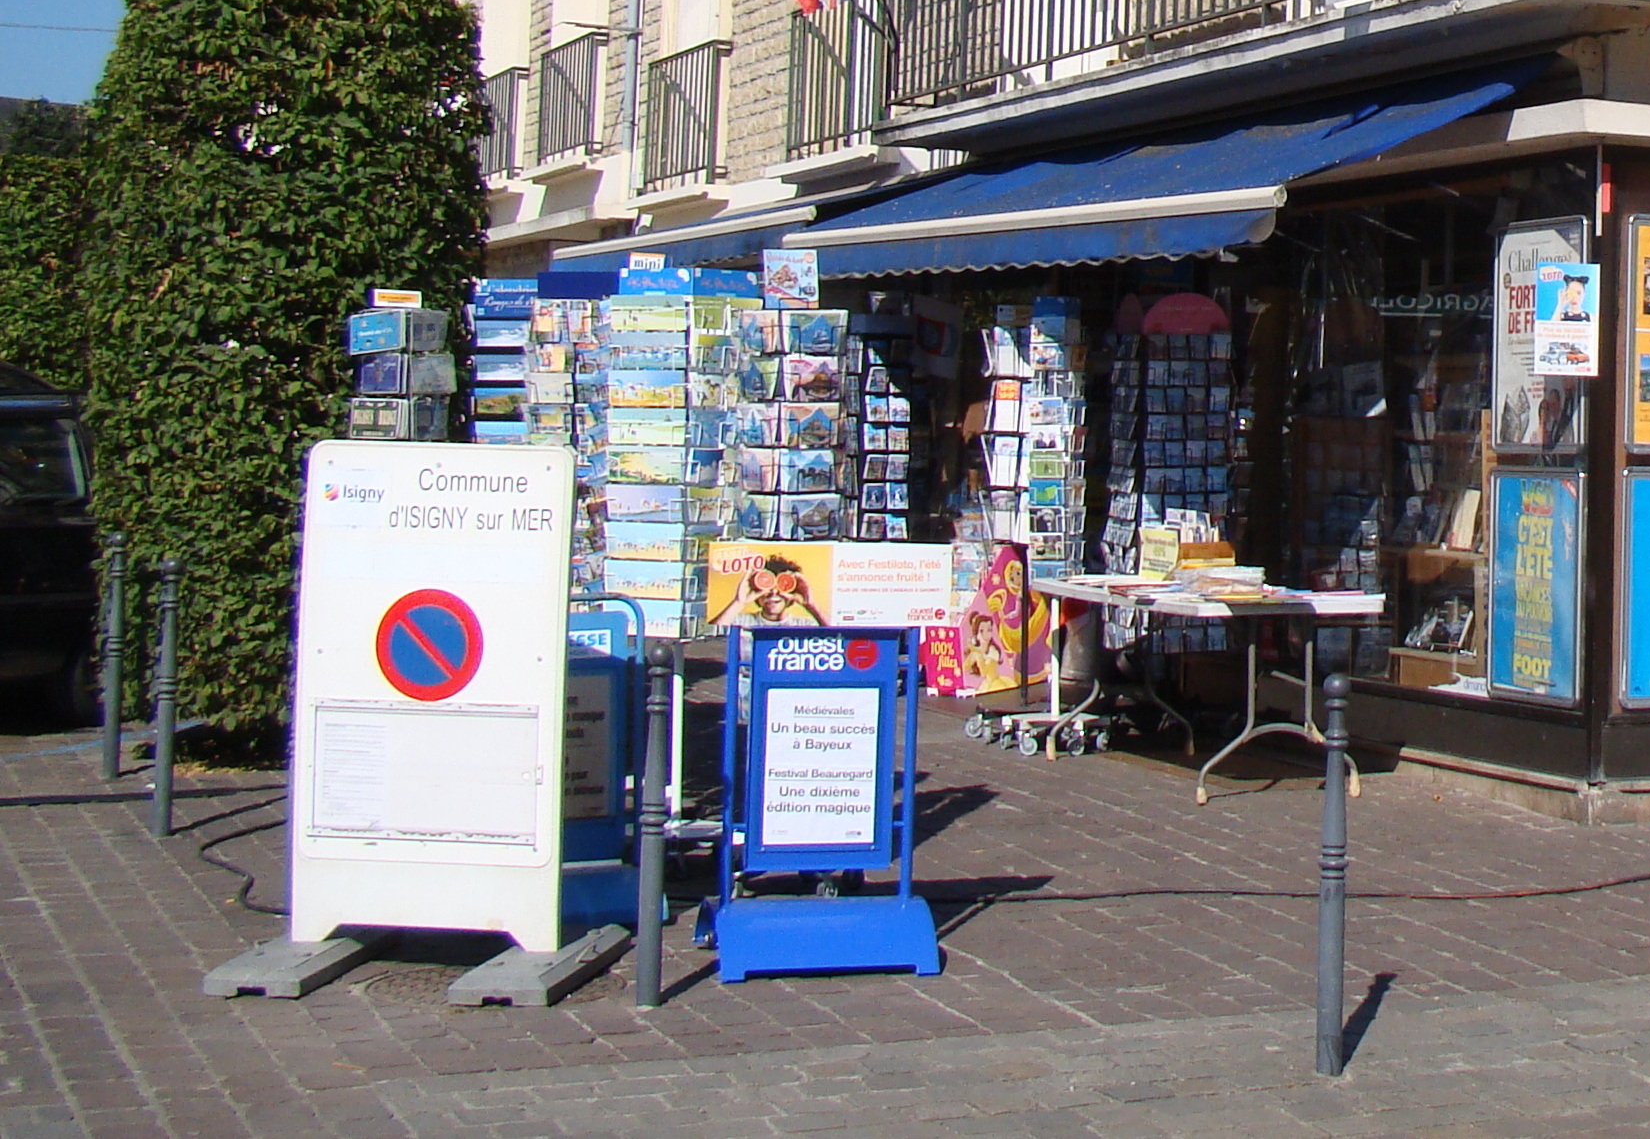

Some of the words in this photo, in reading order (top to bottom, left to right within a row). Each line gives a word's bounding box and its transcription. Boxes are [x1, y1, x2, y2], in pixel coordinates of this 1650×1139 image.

[1508, 311, 1521, 334] DE
[419, 468, 529, 493] Commune
[343, 485, 385, 503] Isigny
[389, 505, 469, 531] d'ISIGNY
[476, 512, 503, 531] sur
[511, 508, 554, 532] MER
[722, 555, 764, 573] LOTO
[838, 560, 865, 569] Avec
[837, 573, 894, 582] s'annonce
[897, 573, 924, 582] fruité
[778, 633, 844, 653] ouest
[930, 641, 955, 655] 100%
[767, 648, 844, 671] france
[1513, 653, 1552, 679] FOOT
[794, 706, 855, 715] Médiévales
[771, 722, 789, 733] Un
[794, 723, 825, 734] beau
[830, 724, 875, 735] succès
[793, 738, 800, 749] à
[805, 739, 852, 752] Bayeux
[768, 768, 808, 778] Festival
[811, 769, 873, 781] Beauregard
[779, 786, 805, 797] Une
[810, 785, 860, 797] dixième
[767, 801, 811, 812] édition
[815, 802, 871, 815] magique
